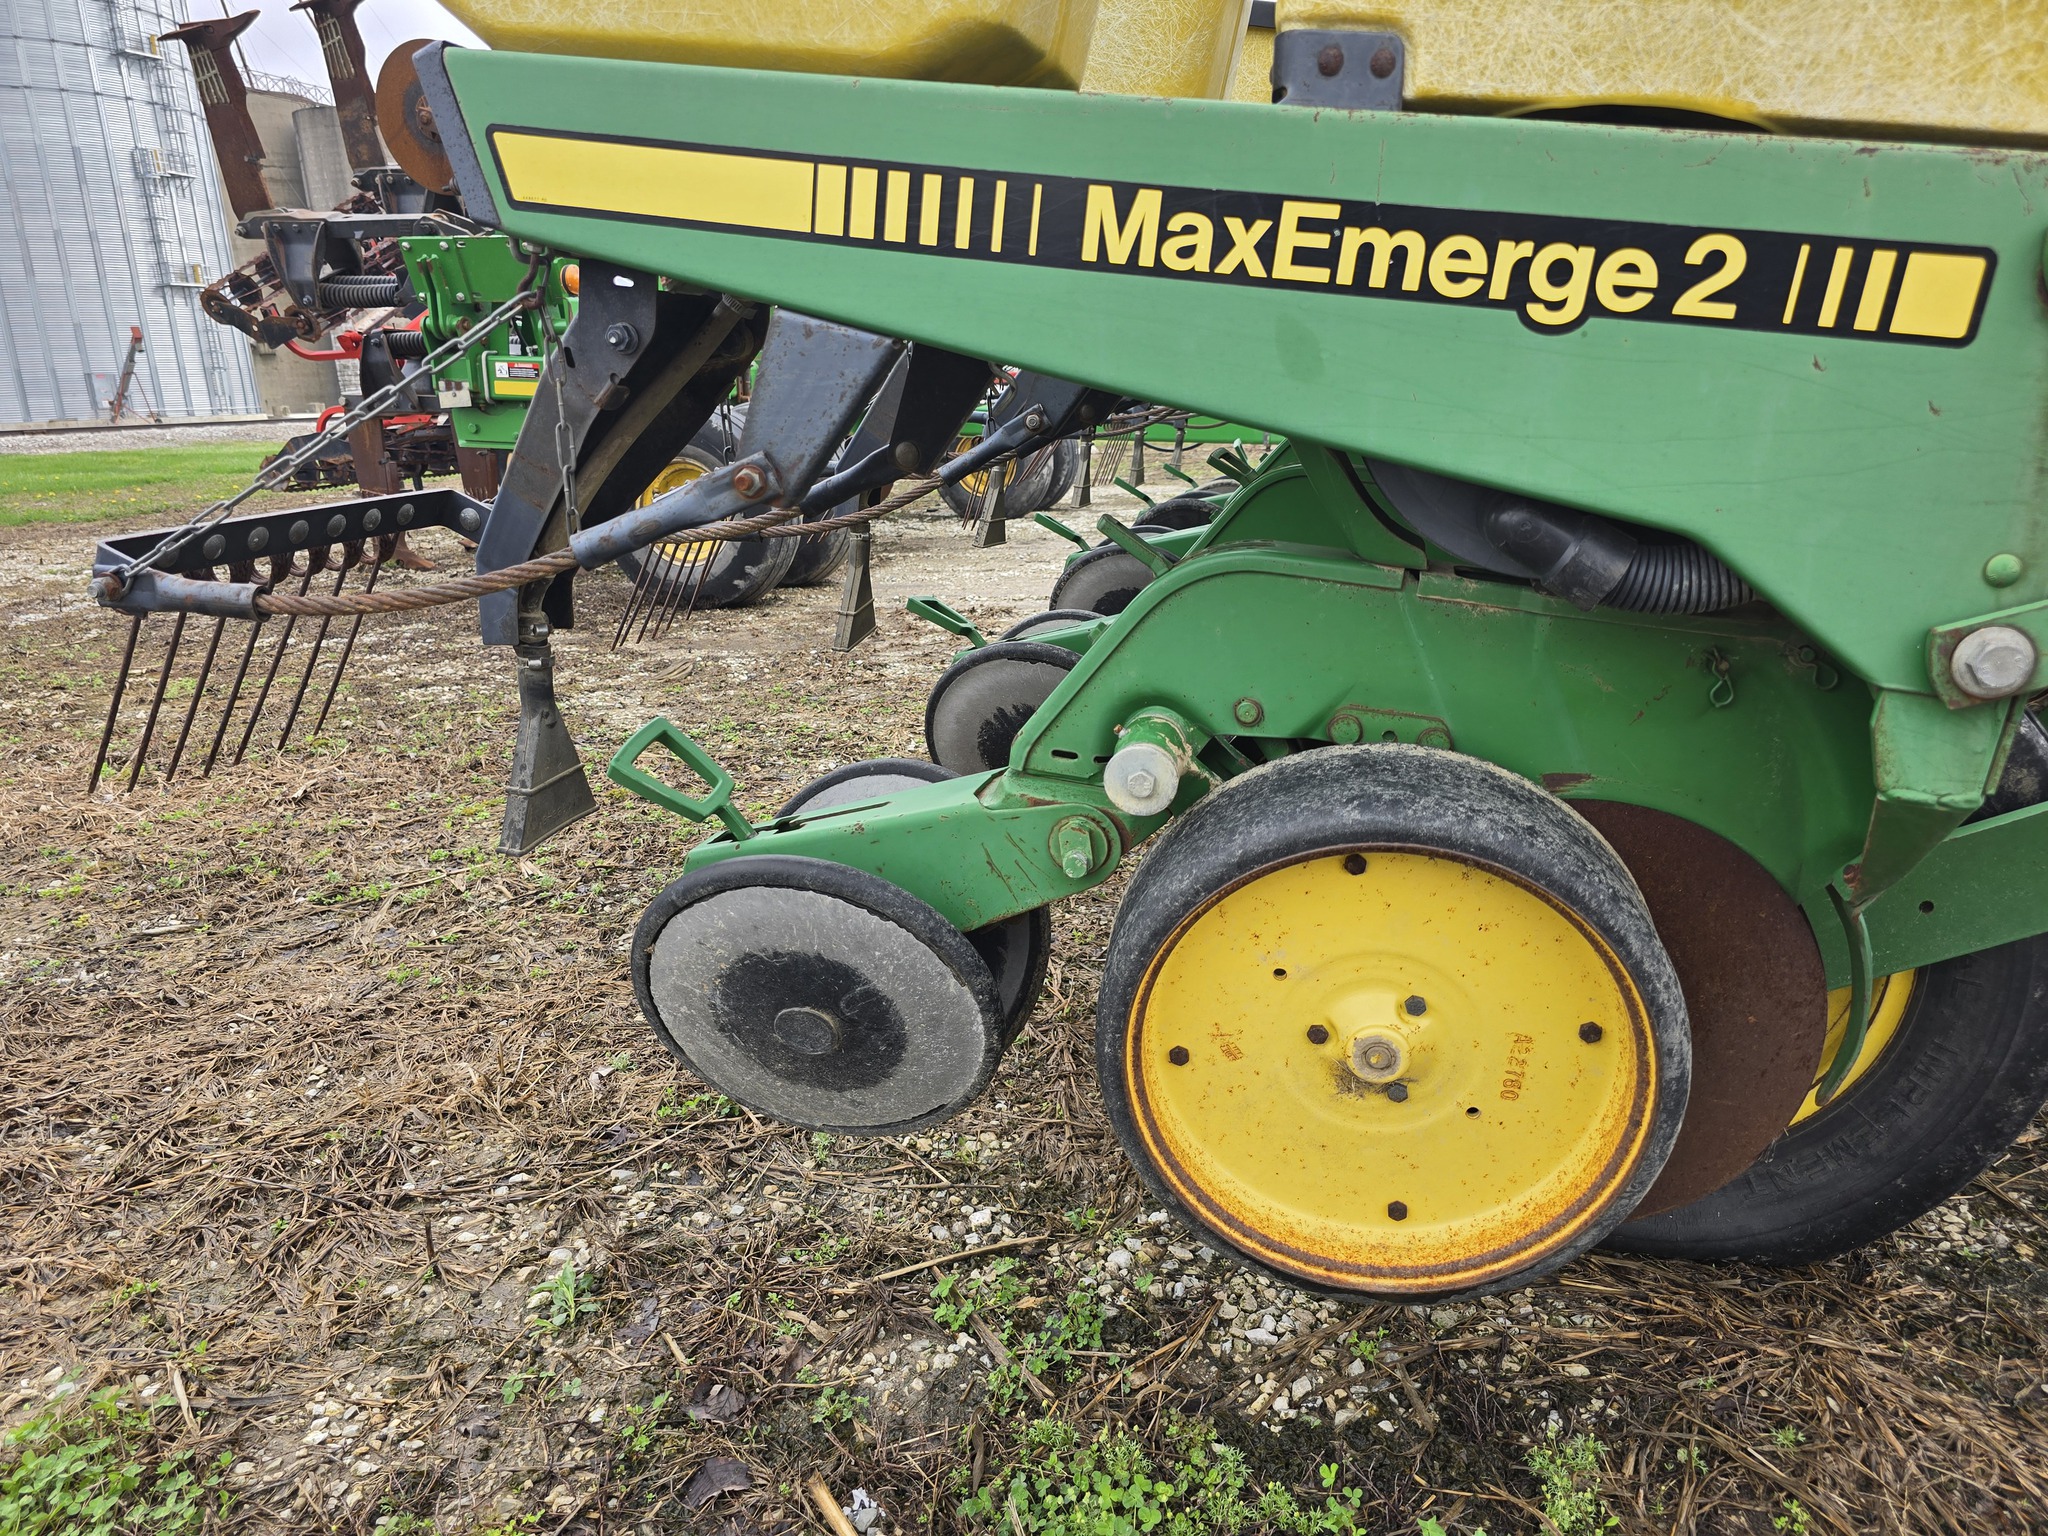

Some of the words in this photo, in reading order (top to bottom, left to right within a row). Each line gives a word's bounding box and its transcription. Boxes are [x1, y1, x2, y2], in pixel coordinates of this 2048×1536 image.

[1081, 184, 1659, 326] MaxEmerge
[1672, 234, 1748, 320] 2
[1743, 1038, 1962, 1200] IMPLEMENT
